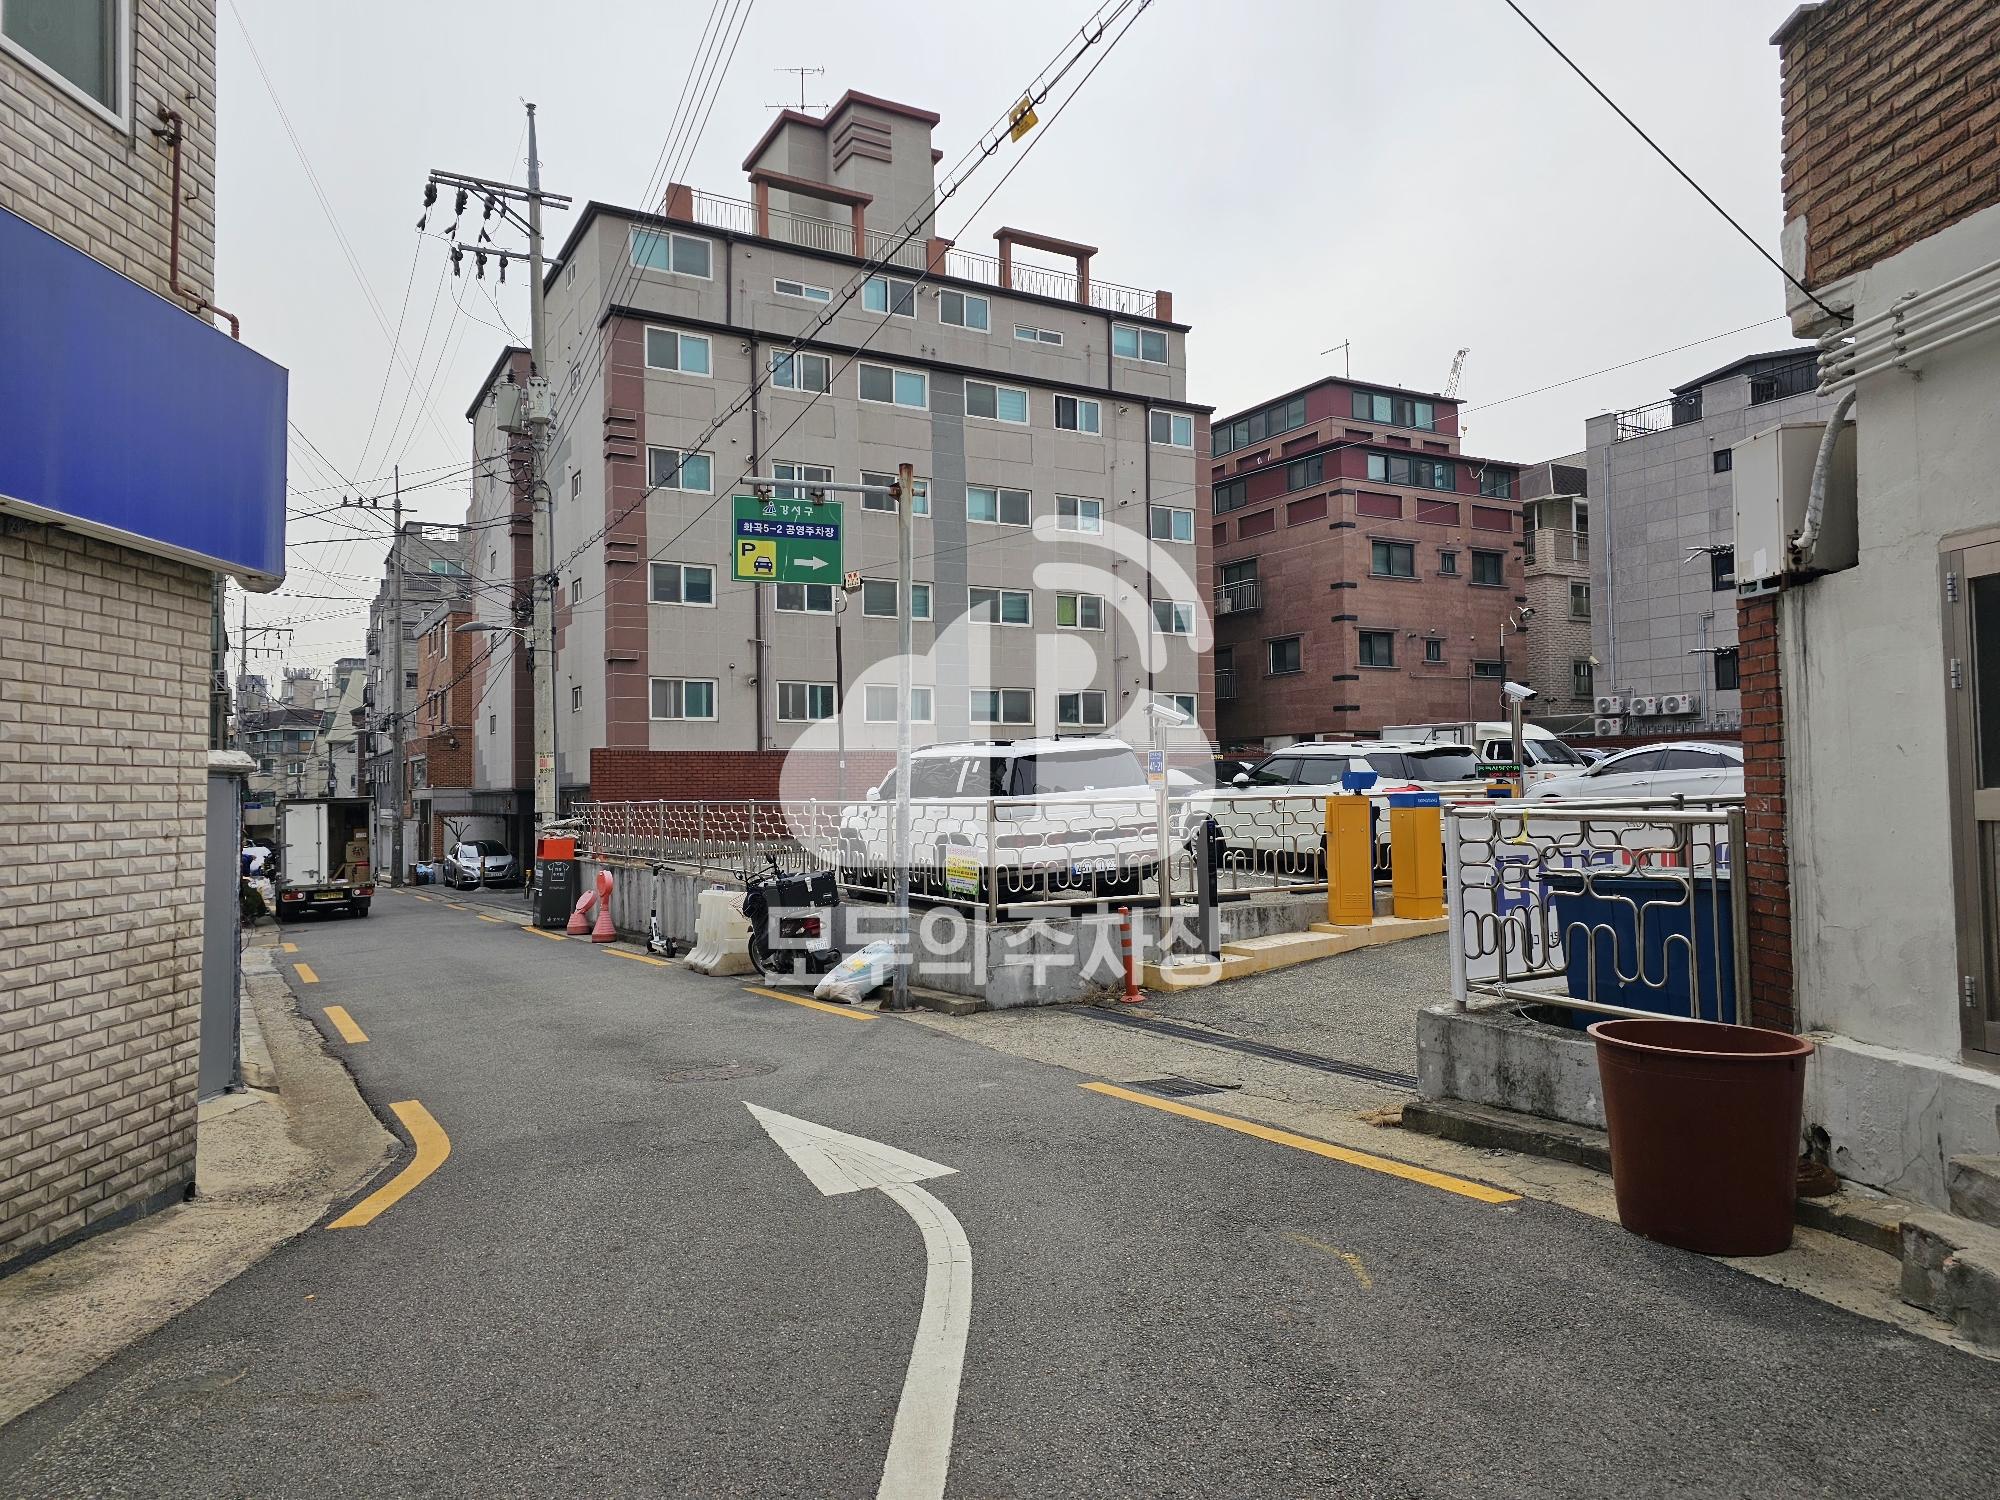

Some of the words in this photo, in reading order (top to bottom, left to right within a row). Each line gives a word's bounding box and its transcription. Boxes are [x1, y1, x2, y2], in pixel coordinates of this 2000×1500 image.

[779, 505, 814, 517] 강서구
[743, 522, 783, 534] 화곡5-2
[785, 524, 835, 538] 공영주차장
[741, 542, 756, 556] P
